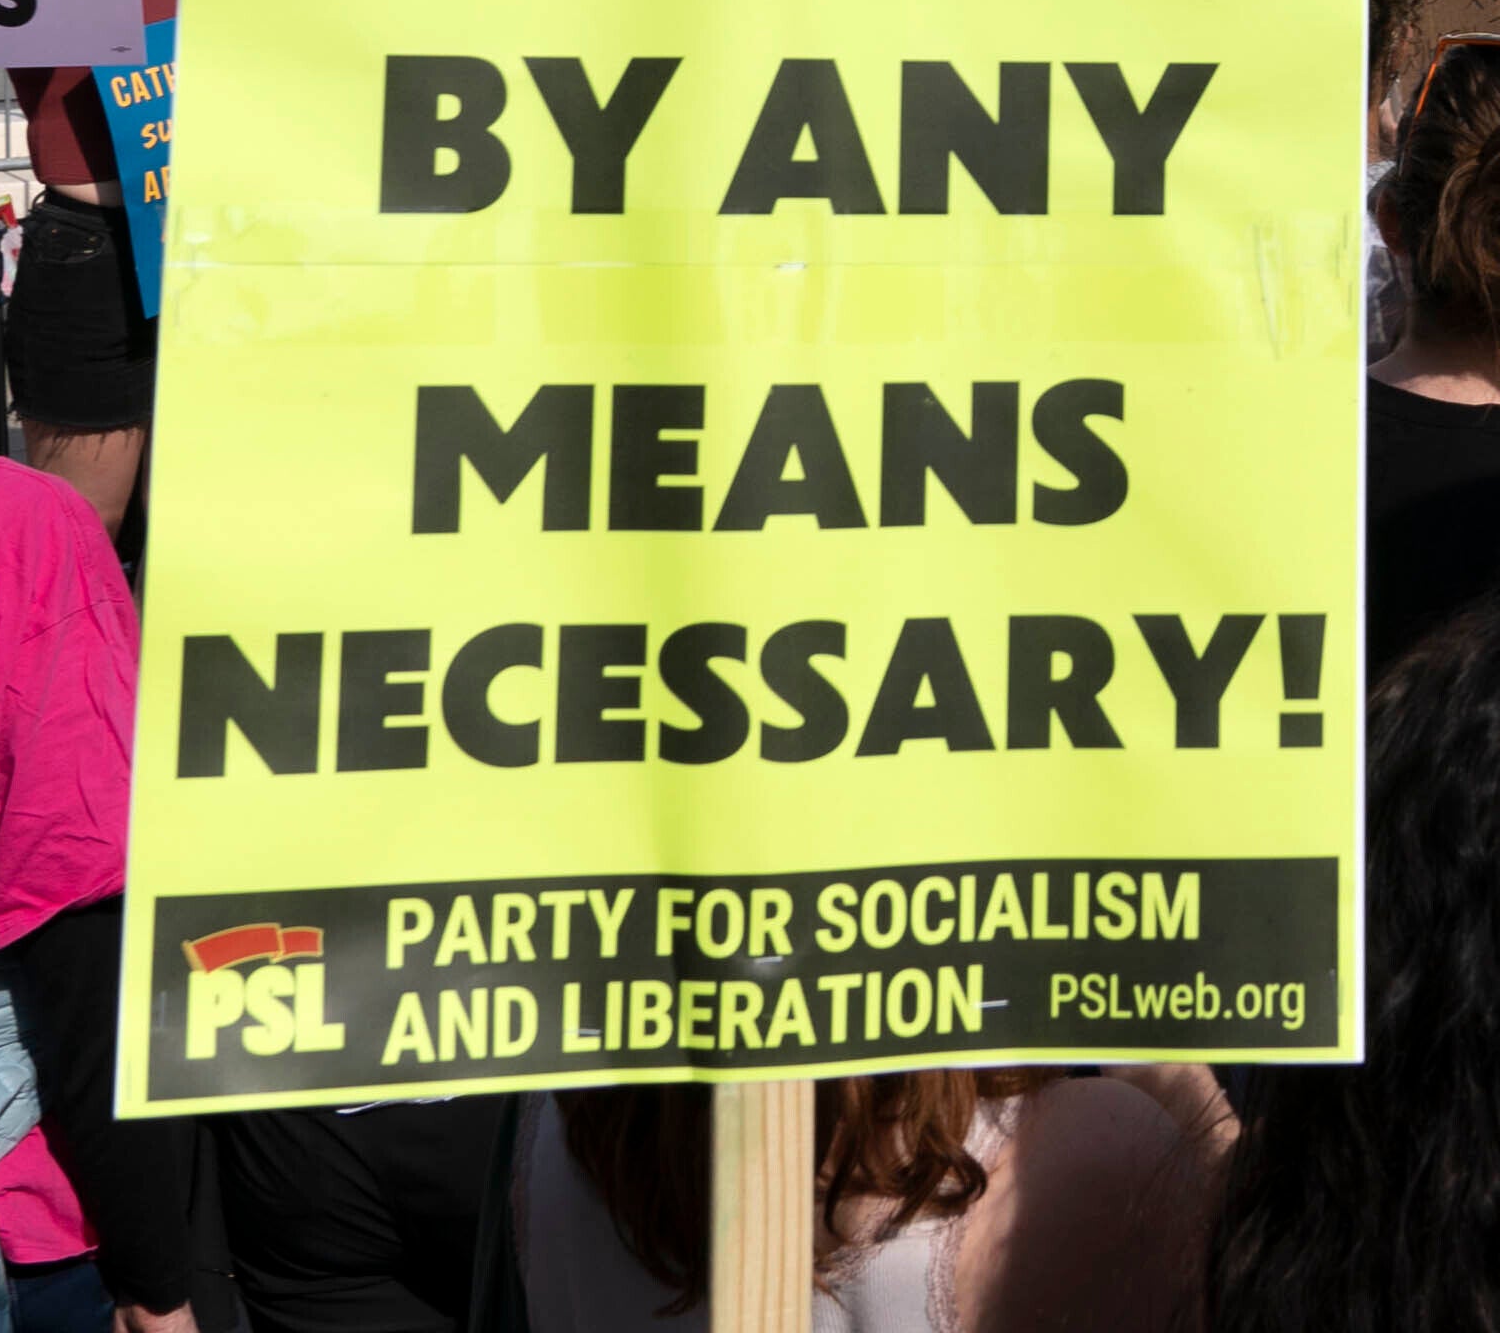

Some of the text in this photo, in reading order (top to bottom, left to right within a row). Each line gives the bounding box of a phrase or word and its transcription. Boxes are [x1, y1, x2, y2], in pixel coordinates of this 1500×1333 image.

[380, 54, 1218, 216] BY ANY
[412, 378, 1129, 534] MEANS
[176, 612, 1327, 779] NECESSARY!
[385, 871, 1202, 970] PARTY FOR SOCIALISM
[185, 963, 345, 1060] PSL
[381, 964, 1307, 1066] AND LIBERATION PSLweb.org
